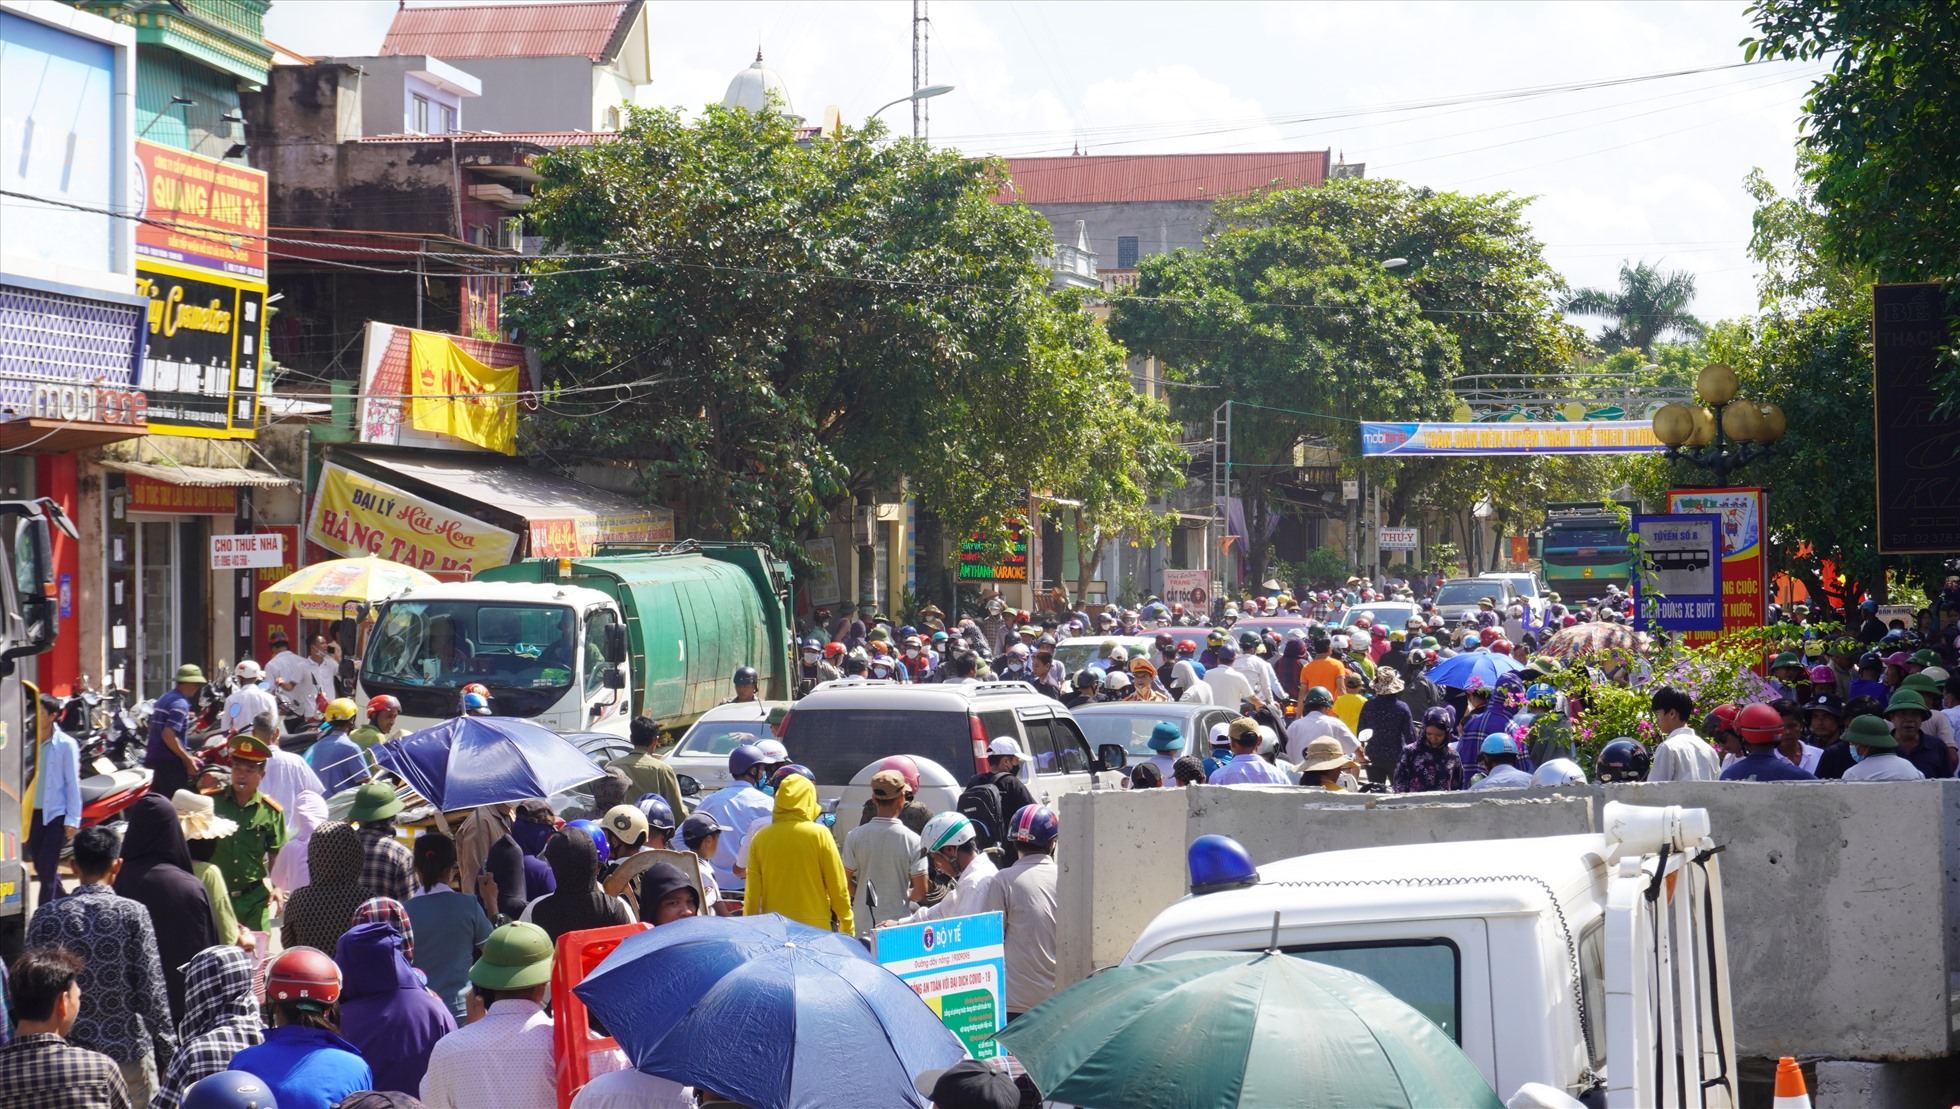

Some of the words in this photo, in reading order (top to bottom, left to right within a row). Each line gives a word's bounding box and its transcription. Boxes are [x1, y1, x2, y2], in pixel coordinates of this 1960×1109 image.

[152, 174, 208, 218] QUANG
[210, 190, 242, 226] ANH
[244, 197, 261, 230] 36
[1364, 431, 1406, 444] mobifone
[1424, 428, 1452, 448] TOÀN
[1455, 428, 1477, 448] DÂN
[1505, 427, 1538, 451] LUYỆN
[1596, 428, 1623, 446] THEO
[352, 488, 374, 512] ĐẠI
[377, 498, 395, 517] LÝ
[396, 505, 434, 535] Hải
[434, 520, 476, 549] Hoa
[320, 510, 385, 554] HÀNG
[1680, 528, 1690, 541] SỐ
[1692, 532, 1698, 540] 8
[215, 539, 232, 552] CHO
[235, 536, 256, 551] THUÊ
[260, 535, 278, 550] NHÀ
[994, 565, 1025, 579] KARAOKE
[1737, 578, 1758, 597] CUỘC
[1685, 603, 1694, 618] XE
[1696, 599, 1715, 618] BUÝT
[936, 927, 947, 948] BỘ
[948, 930, 953, 943] Y
[954, 922, 962, 942] TẾ
[923, 982, 930, 993] AN
[930, 978, 942, 992] TOÀN
[958, 974, 968, 989] DỊCH
[970, 973, 981, 984] COVID
